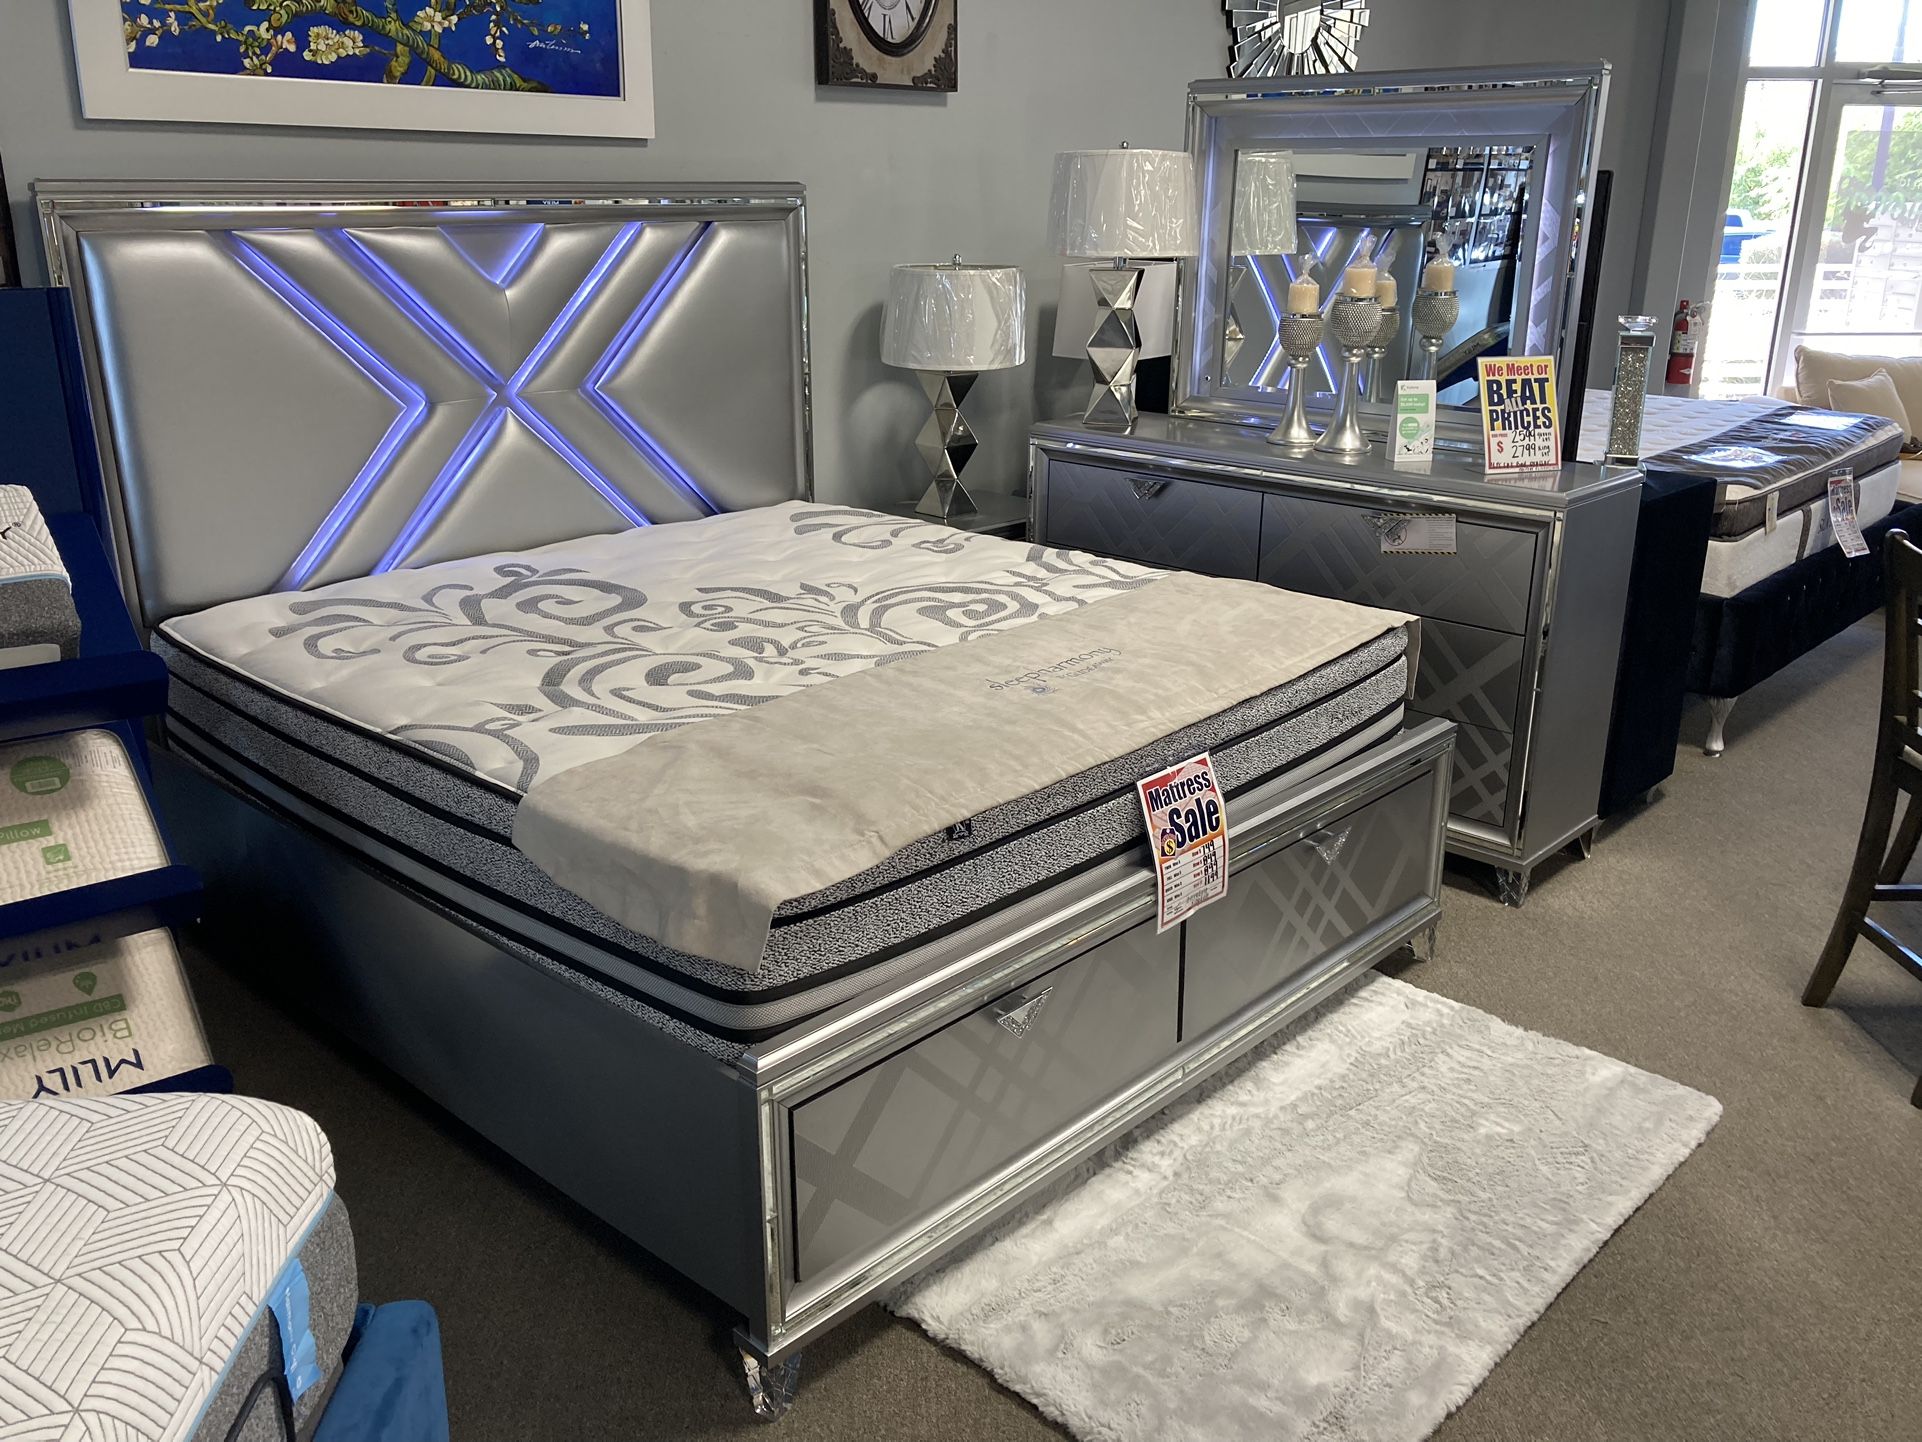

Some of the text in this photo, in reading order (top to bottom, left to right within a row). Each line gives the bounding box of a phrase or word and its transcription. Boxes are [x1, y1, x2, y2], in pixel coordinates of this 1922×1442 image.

[1484, 363, 1549, 377] We Meet or
[1486, 377, 1549, 407] BEAT
[1504, 396, 1524, 412] ALL
[1488, 406, 1553, 431] PRICES
[1511, 429, 1537, 444] 2599
[1511, 443, 1537, 458] 2799
[1148, 770, 1212, 813] Mattress
[1168, 797, 1220, 849] Sale
[0, 1017, 133, 1063] BioRelax
[32, 1047, 145, 1099] MLILY
